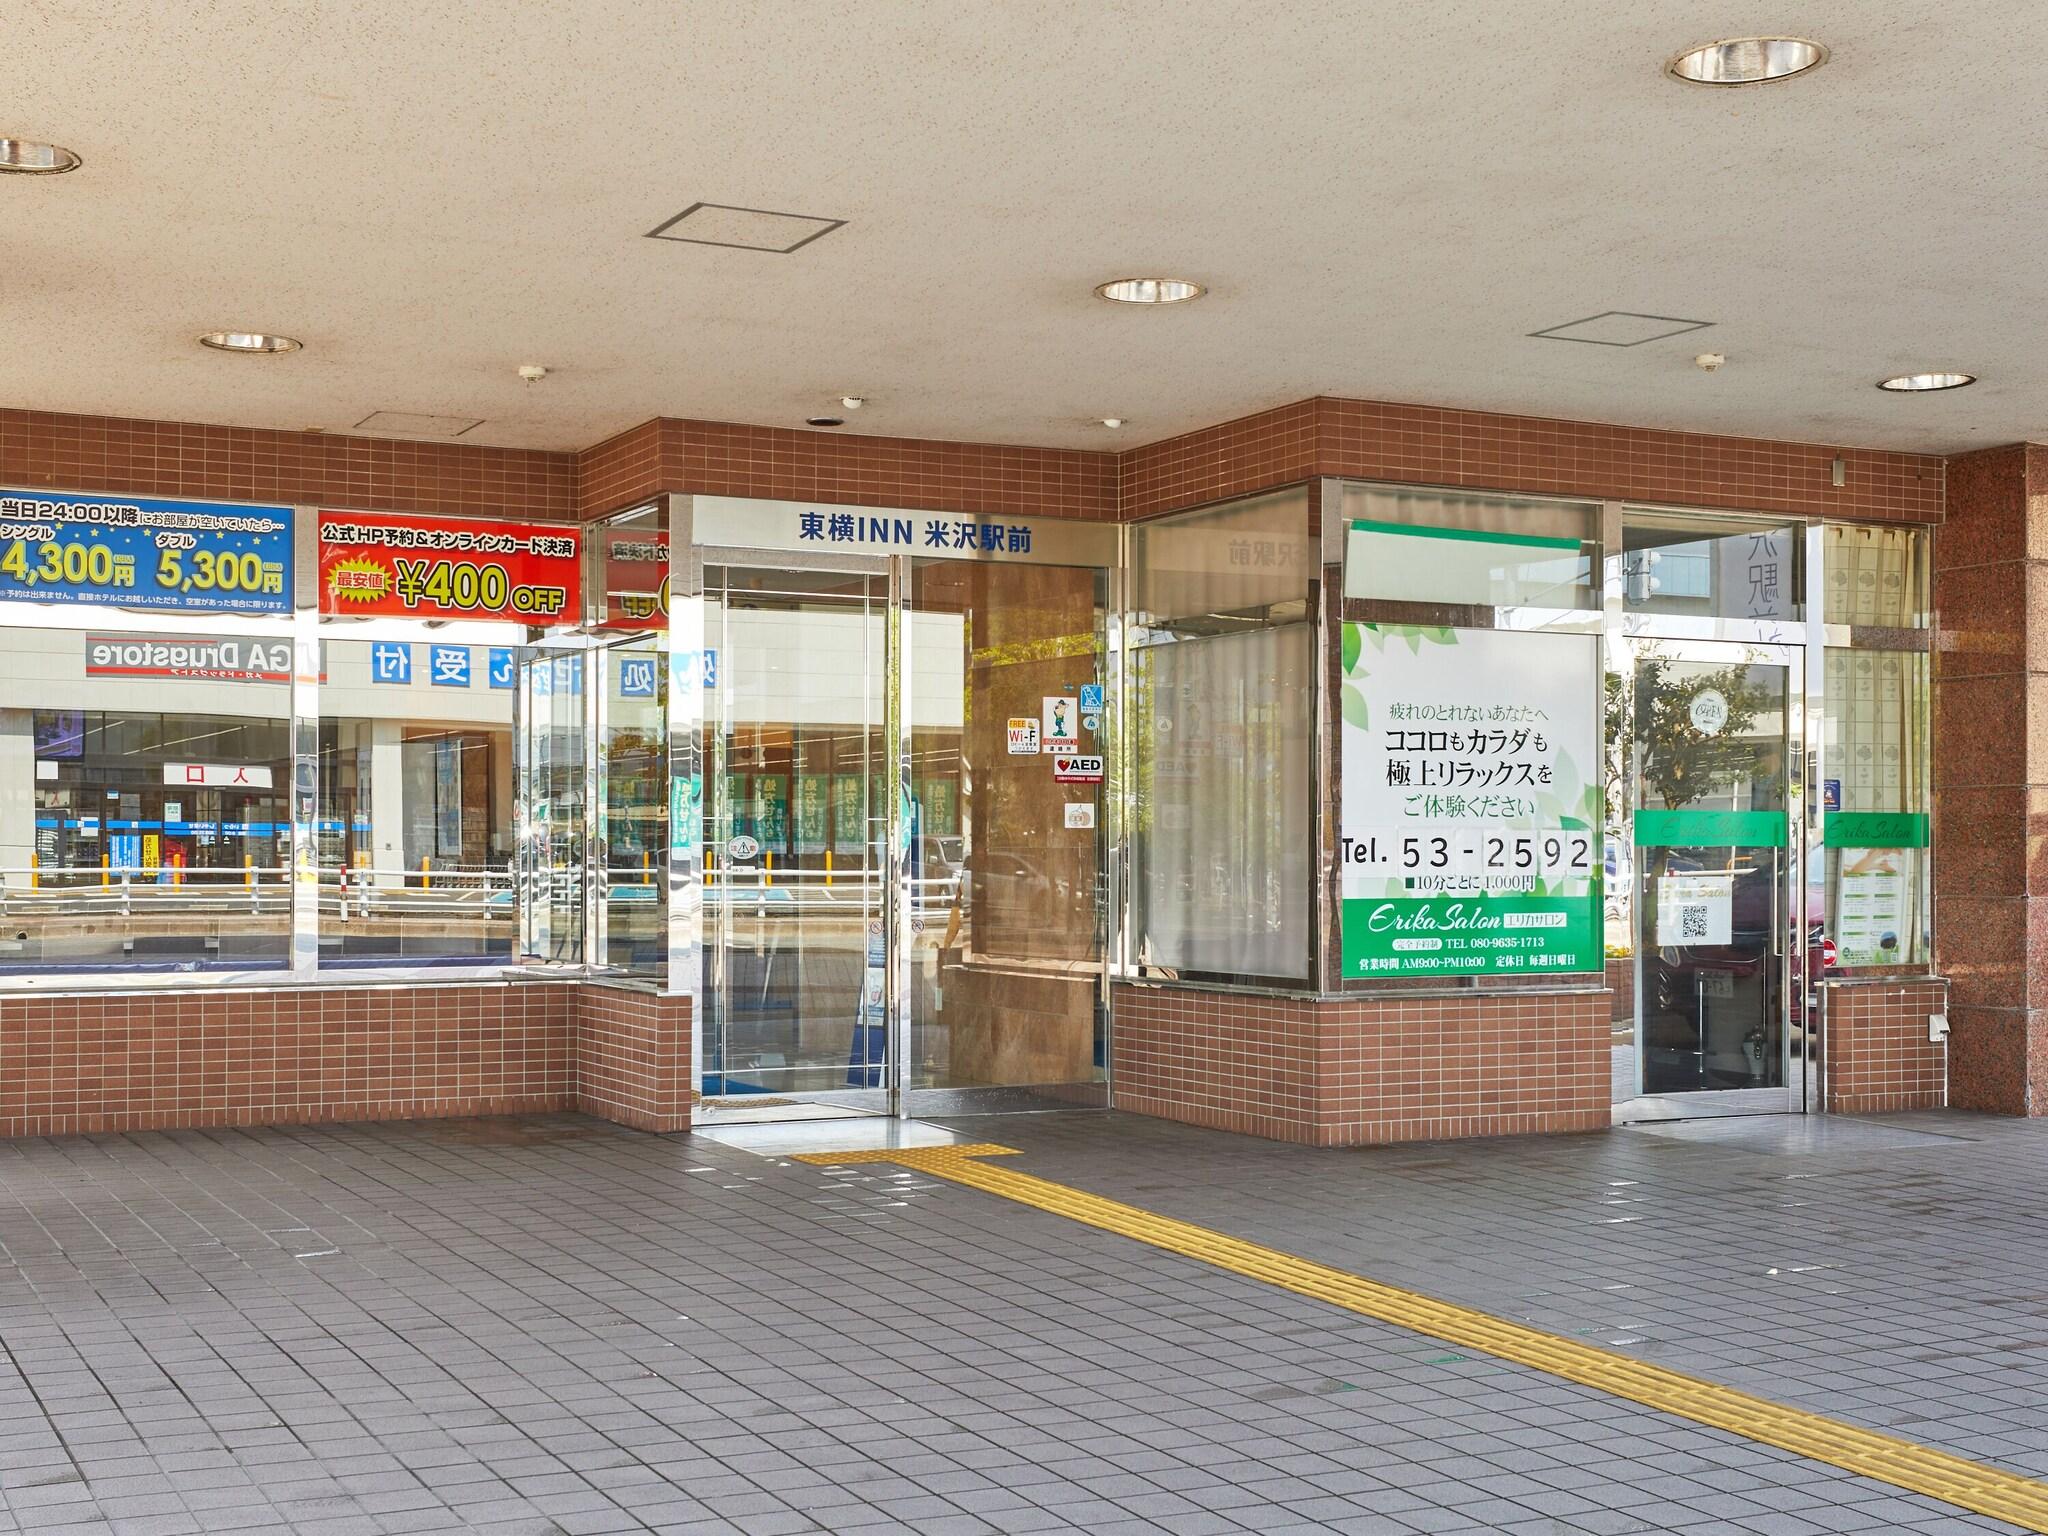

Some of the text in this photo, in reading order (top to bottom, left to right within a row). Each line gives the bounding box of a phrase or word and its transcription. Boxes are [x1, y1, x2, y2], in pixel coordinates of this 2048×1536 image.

[2, 525, 53, 540] シングル
[157, 533, 195, 548] ダブル
[799, 512, 1032, 553] 東横INN 米沢駅前
[1, 539, 135, 587] 4,300円
[156, 549, 283, 594] 5,300円
[336, 571, 384, 588] 最安値
[396, 560, 565, 613] ¥400 OFF
[1389, 702, 1549, 722] 疲れのとれないあなたへ
[1009, 720, 1025, 728] FREE
[1009, 730, 1037, 742] Wi-F
[1385, 727, 1548, 755] ココロもカラダも
[1070, 759, 1101, 770] AED
[1386, 758, 1553, 788] 極上リラックスを
[1403, 793, 1534, 818] ご体験ください
[1827, 819, 1912, 840] Erika Salon
[1342, 837, 1588, 868] Tel. 53-2592
[1368, 904, 1438, 932] Erika
[1437, 903, 1502, 931] Salon
[1446, 938, 1467, 949] TEL
[1470, 937, 1545, 949] 080-9635-1713
[1359, 958, 1400, 970] 営業時間
[1495, 955, 1524, 967] 定休日
[1529, 954, 1576, 966] 毎週日曜日
